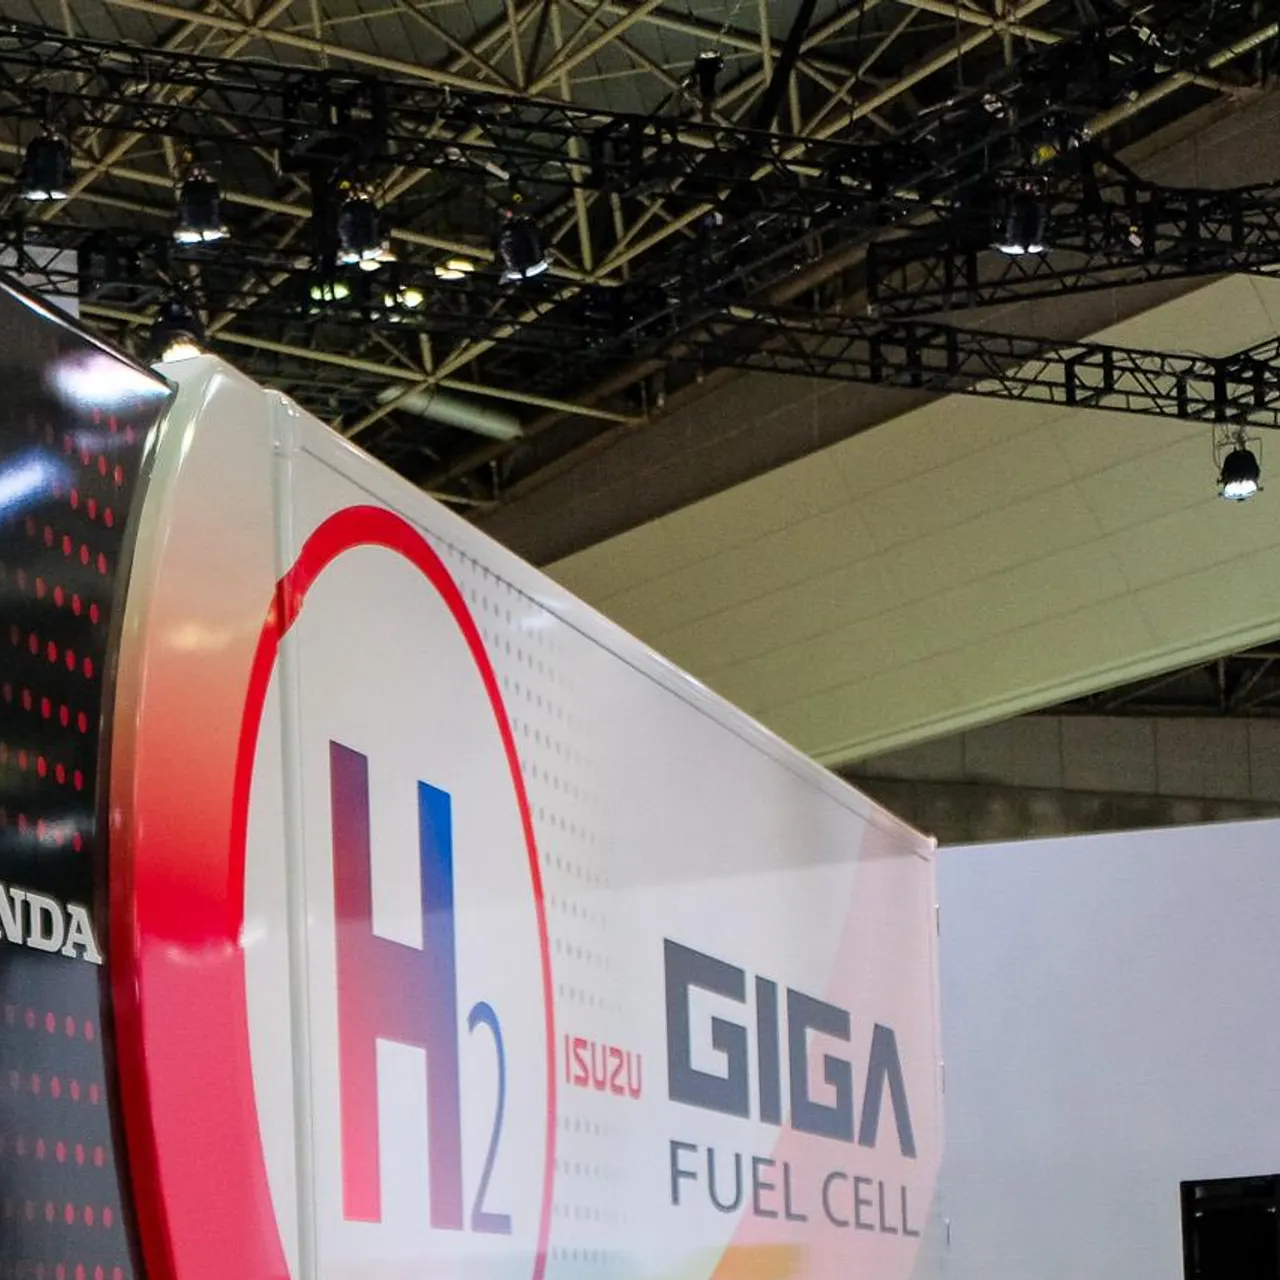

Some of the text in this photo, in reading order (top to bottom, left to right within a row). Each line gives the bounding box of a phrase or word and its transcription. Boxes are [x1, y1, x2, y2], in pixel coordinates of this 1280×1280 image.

[330, 739, 513, 1235] H2
[564, 1033, 642, 1100] ISUZU
[663, 937, 917, 1159] GIGA
[669, 1139, 920, 1237] FUEL CELL
